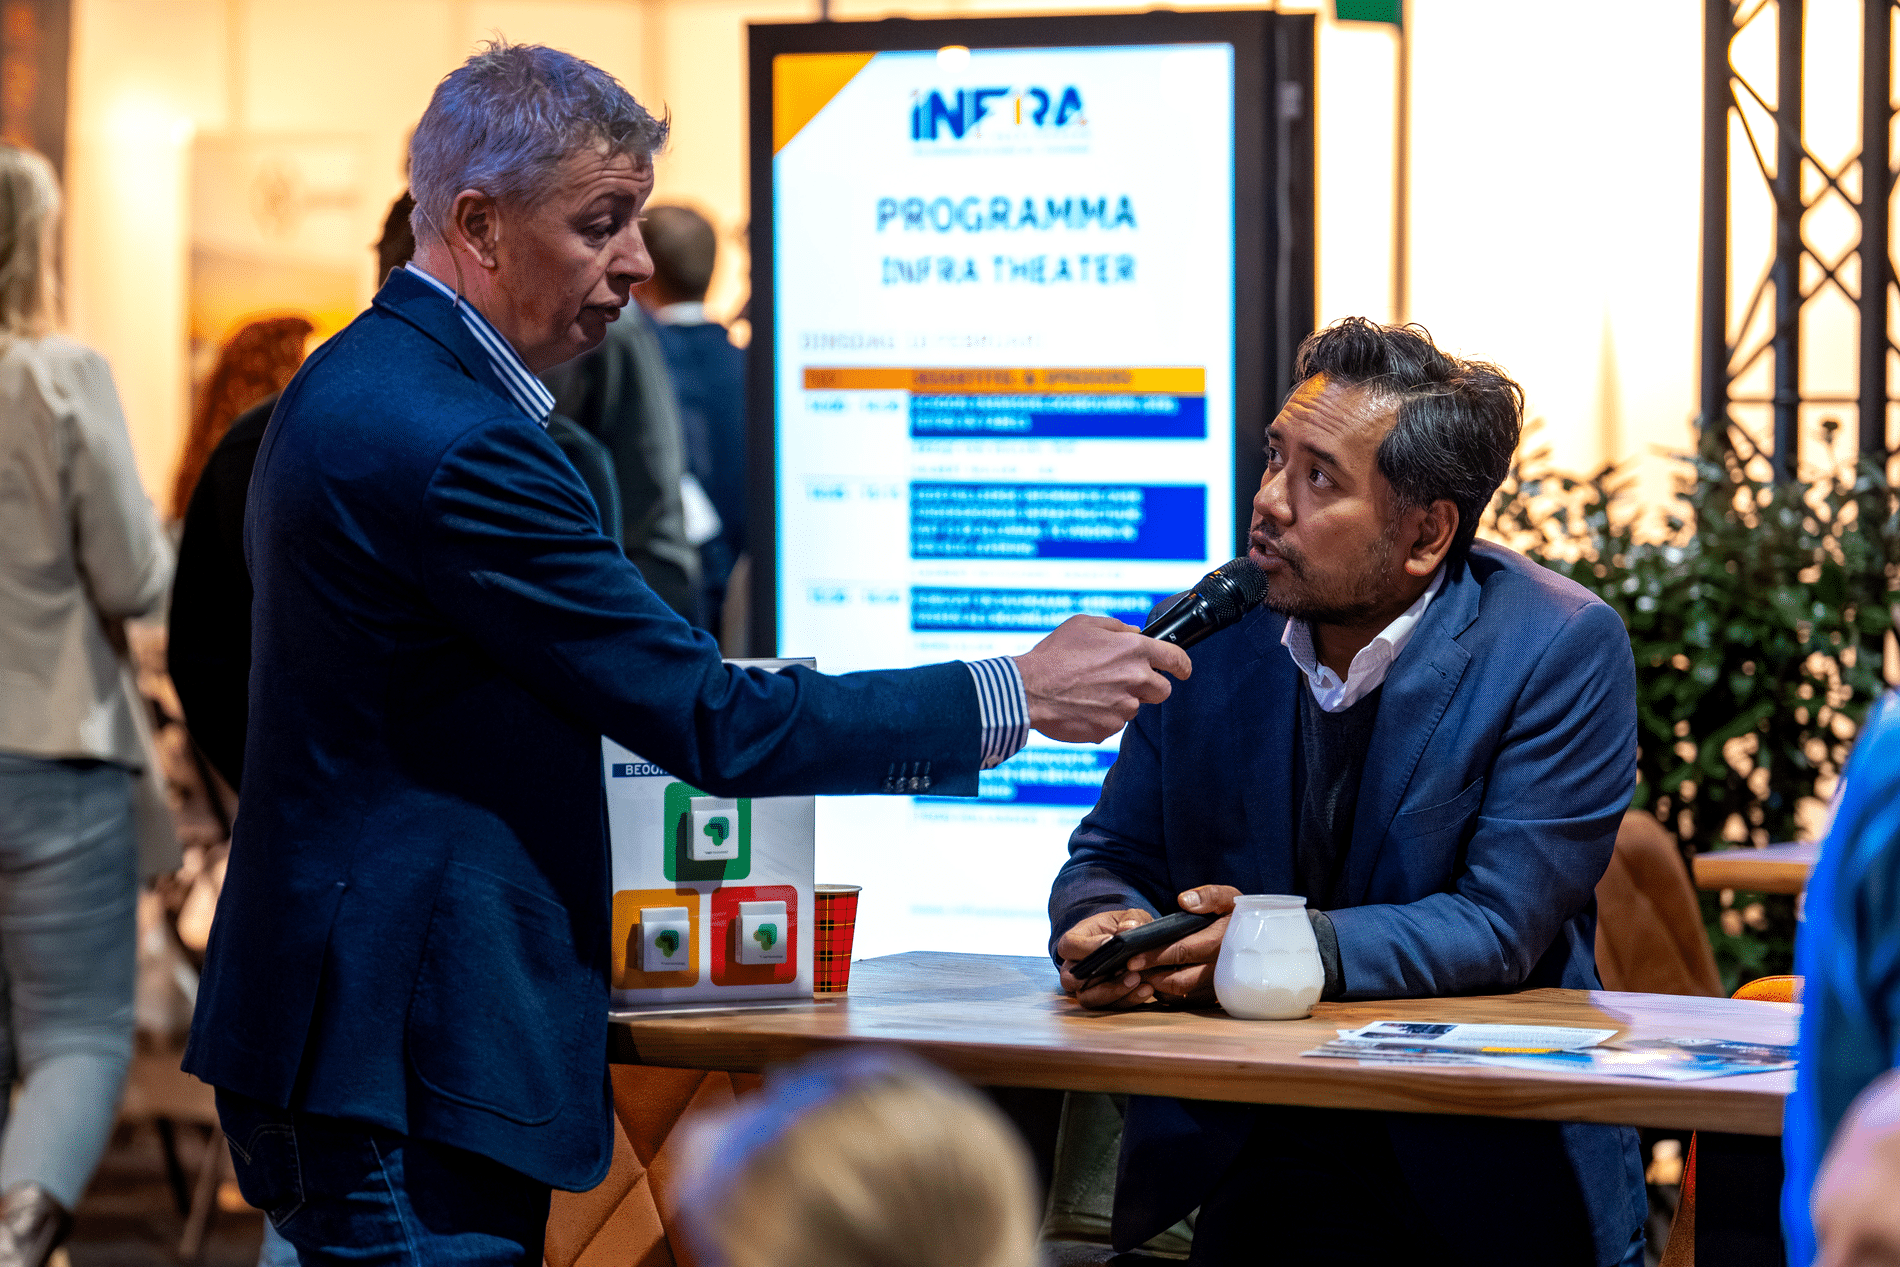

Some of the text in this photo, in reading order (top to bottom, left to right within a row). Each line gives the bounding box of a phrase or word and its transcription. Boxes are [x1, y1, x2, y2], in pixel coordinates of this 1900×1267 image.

[876, 196, 1138, 231] PROGRAMMA
[882, 254, 1137, 284] INFRA THEATER
